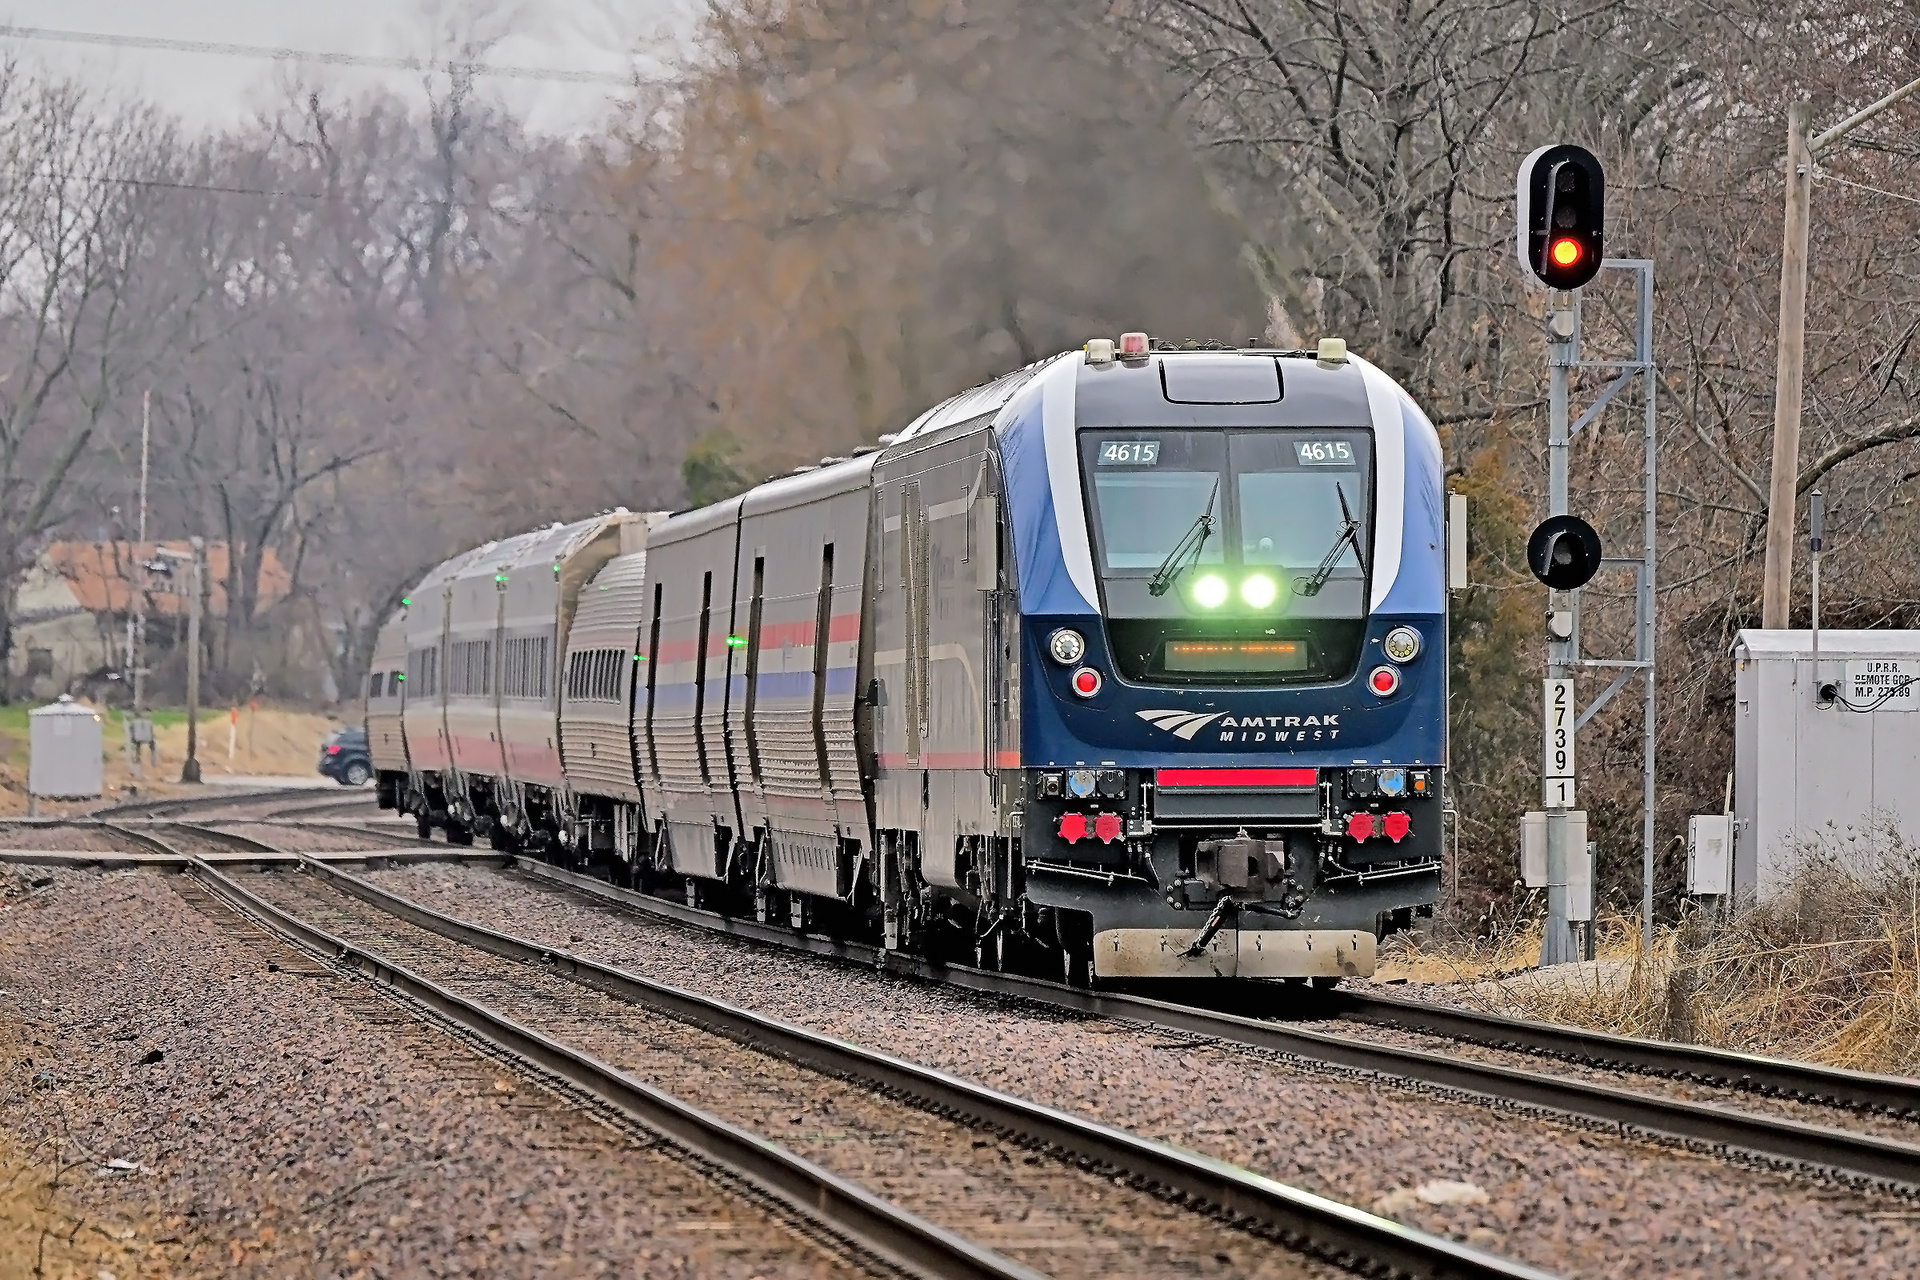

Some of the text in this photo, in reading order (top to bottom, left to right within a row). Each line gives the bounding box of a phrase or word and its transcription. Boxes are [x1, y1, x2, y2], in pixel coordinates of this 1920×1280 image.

[1104, 443, 1155, 461] 4615
[1300, 442, 1349, 460] 4615
[1867, 662, 1901, 673] U.P.R.R.
[1855, 686, 1875, 697] M.P.
[1220, 714, 1339, 728] AMTRAK
[1219, 729, 1339, 742] MIDWEST
